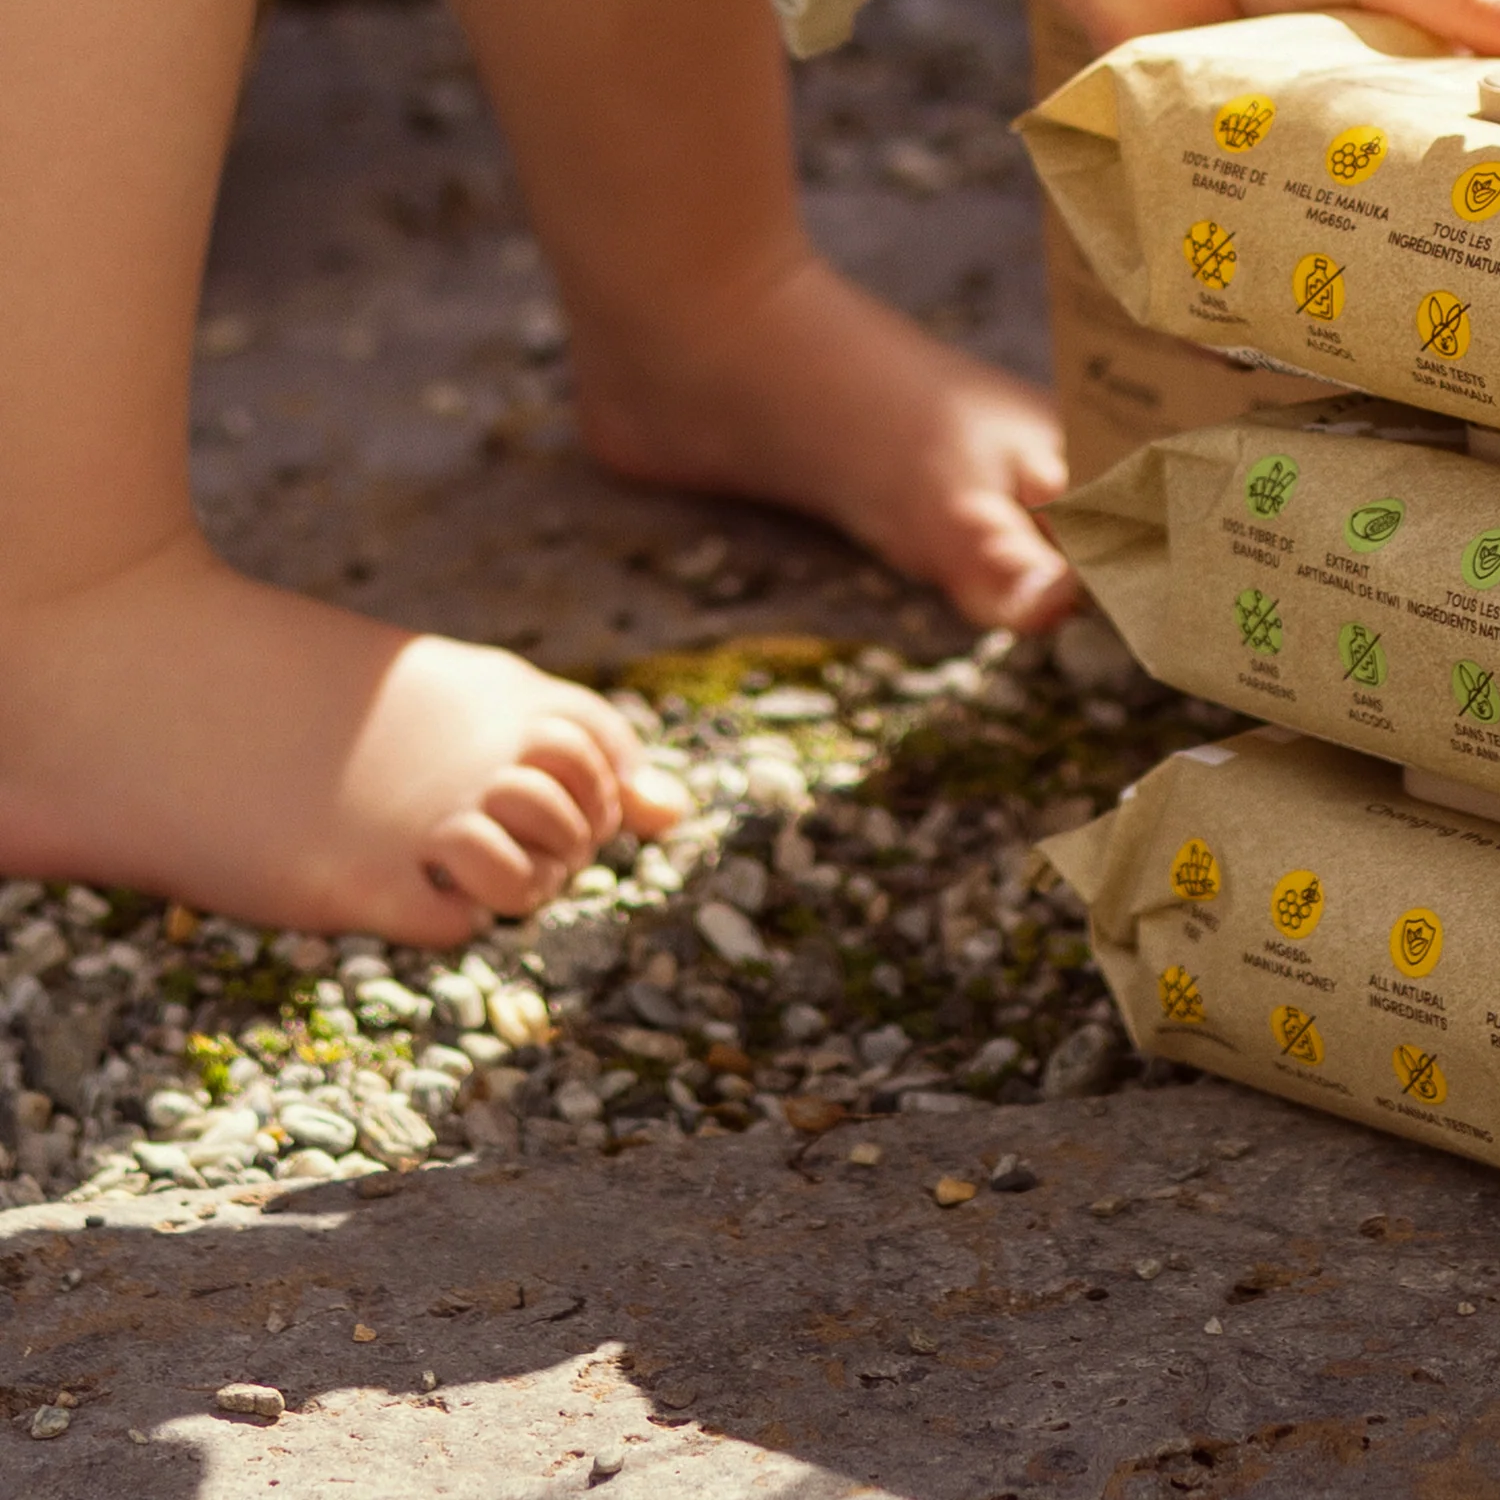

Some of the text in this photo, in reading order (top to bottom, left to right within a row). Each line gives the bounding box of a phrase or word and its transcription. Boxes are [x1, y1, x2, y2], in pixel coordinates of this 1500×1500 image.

[1182, 150, 1268, 186] 100% FIBRE DE
[1191, 173, 1247, 201] BAMBOU
[1283, 179, 1390, 221] MIEL DE MANUKA
[1387, 230, 1464, 264] INGRÉDIENTS
[1433, 222, 1492, 251] TOUS LES
[1416, 357, 1486, 389] SANS TESTS
[1232, 540, 1280, 569] BAMBOU
[1250, 525, 1279, 546] FIBRE
[1280, 536, 1295, 554] DE
[1325, 552, 1370, 579] EXTRAIT
[1297, 563, 1400, 610] ARTISANAL DE KIWI
[1406, 601, 1478, 635] INGRÉDIENTS
[1446, 590, 1500, 620] TOUS LES
[1454, 723, 1485, 744] SANS
[1366, 802, 1458, 838] Changing
[1460, 829, 1494, 850] the
[1242, 952, 1338, 993] MANUKA HONEY
[1369, 974, 1446, 1010] ALL NATURAL
[1369, 994, 1447, 1031] INGREDIENTS
